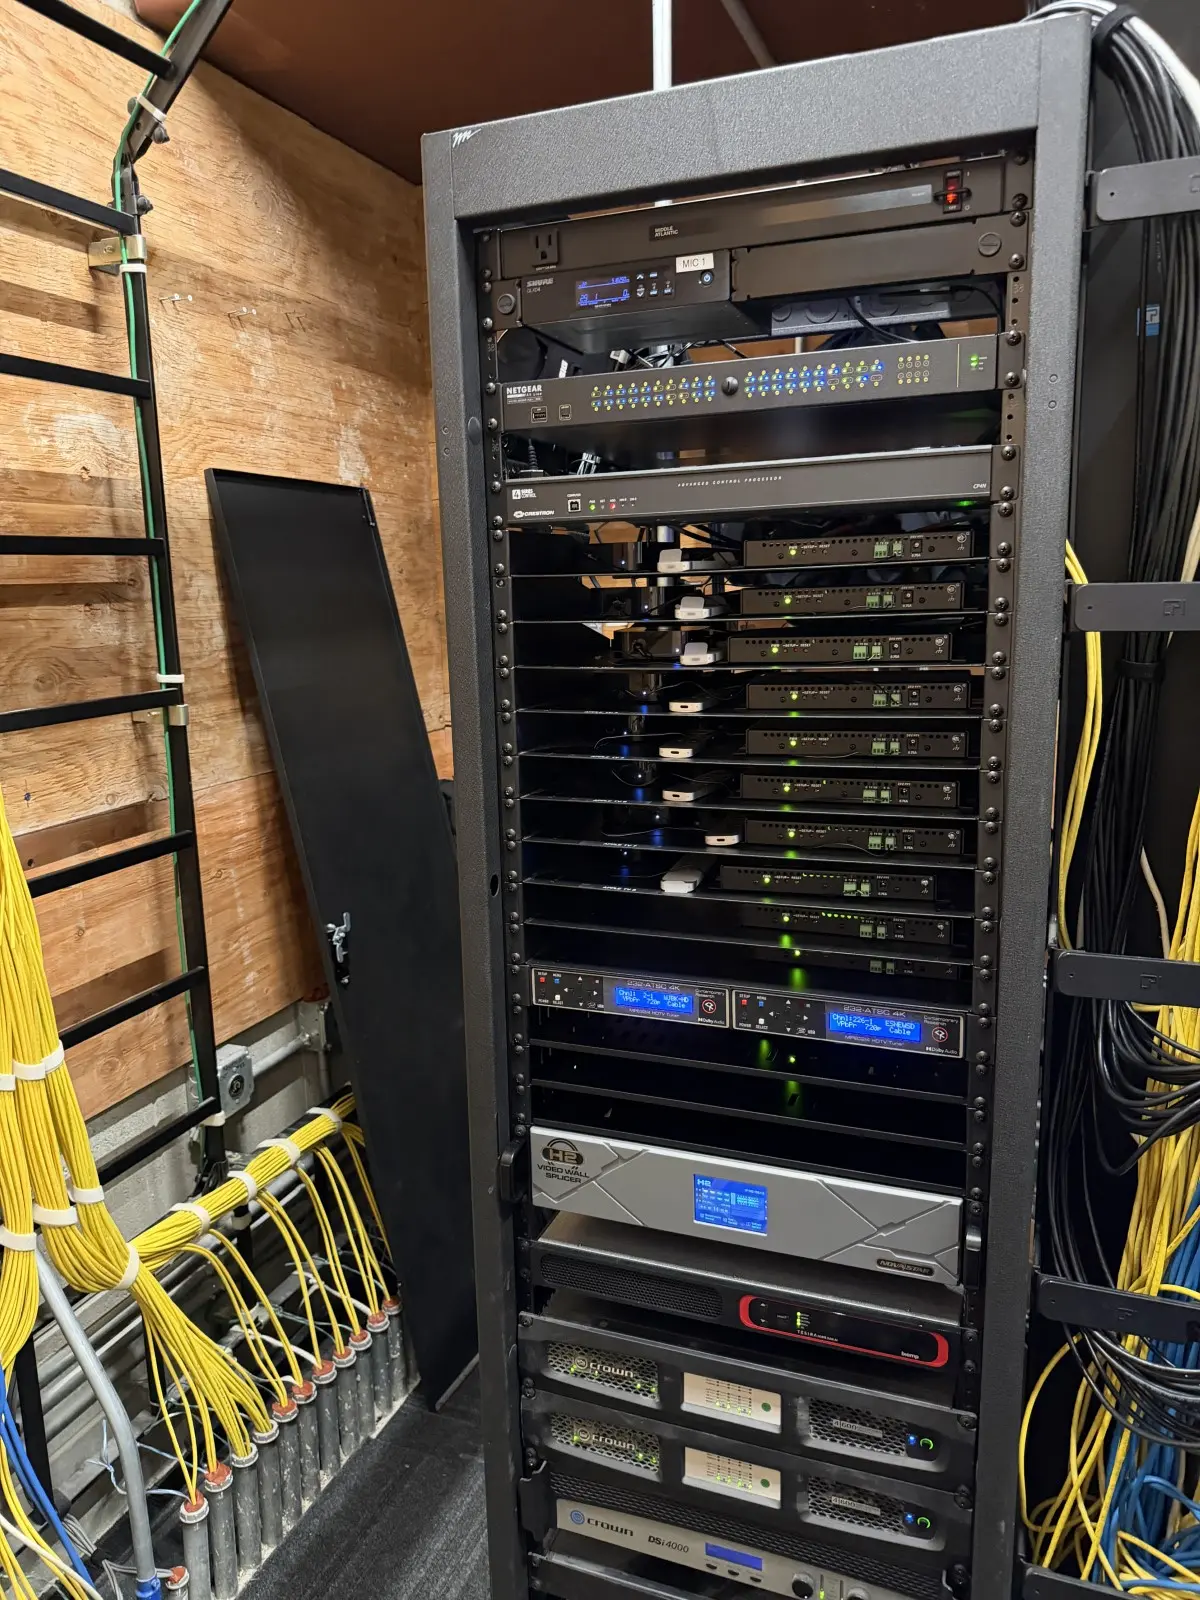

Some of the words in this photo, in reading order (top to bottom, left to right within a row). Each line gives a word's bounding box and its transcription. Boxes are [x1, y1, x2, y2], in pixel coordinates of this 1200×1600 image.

[654, 225, 674, 233] MIDDLE
[654, 229, 679, 237] ATLANTIC
[682, 258, 699, 268] MIC
[526, 278, 554, 287] SHURE
[506, 384, 543, 395] NETGEAR
[667, 1001, 686, 1009] Cable
[892, 1010, 906, 1018] 4K
[889, 1027, 911, 1036] Cable
[549, 1149, 578, 1165] H2
[537, 1163, 564, 1174] VIDEO
[564, 1168, 590, 1179] WALL
[545, 1172, 582, 1184] SPLICER
[697, 1178, 711, 1187] H2
[880, 1260, 931, 1274] NOVASTAR
[589, 1362, 634, 1378] crown
[592, 1434, 635, 1450] crown
[586, 1518, 634, 1537] crown
